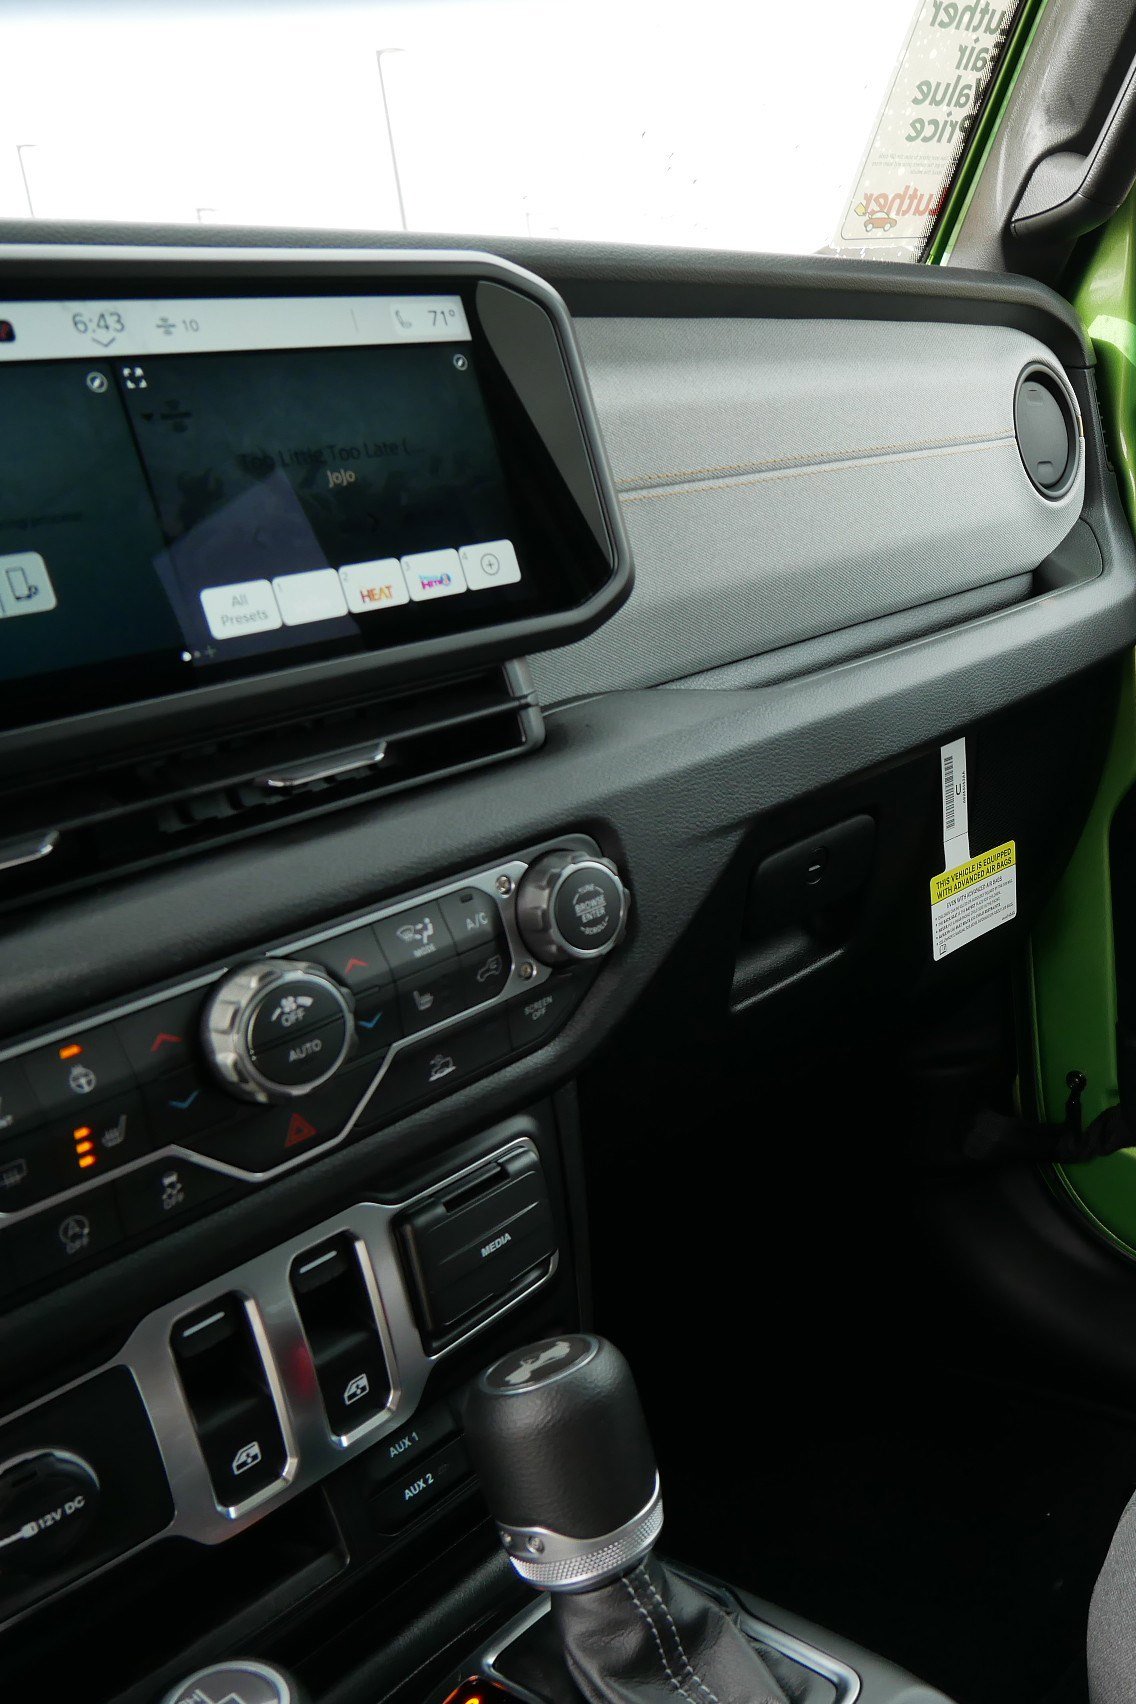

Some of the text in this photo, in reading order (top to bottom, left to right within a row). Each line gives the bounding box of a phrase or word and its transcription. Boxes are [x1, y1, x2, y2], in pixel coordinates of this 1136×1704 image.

[72, 308, 456, 335] 6:43 10 71°
[328, 443, 361, 462] Too
[363, 440, 399, 459] Late
[231, 593, 248, 608] All
[359, 584, 394, 605] HEAT
[220, 607, 269, 628] Presets
[936, 847, 1012, 891] THIS VEHICLE IS EQUIPPED
[936, 856, 1013, 900] WITH ADVANCED AIR BAGS
[575, 895, 606, 914] BROWSE
[581, 906, 606, 924] ENTER
[465, 911, 489, 931] A/C
[523, 995, 554, 1016] SCREEN
[281, 1006, 306, 1028] OFF
[288, 1039, 323, 1063] AUTO
[480, 1232, 513, 1258] MEDIA
[388, 1431, 420, 1459] AUX 1
[403, 1472, 435, 1502] AUX 2
[38, 1495, 86, 1529] 12V DC
